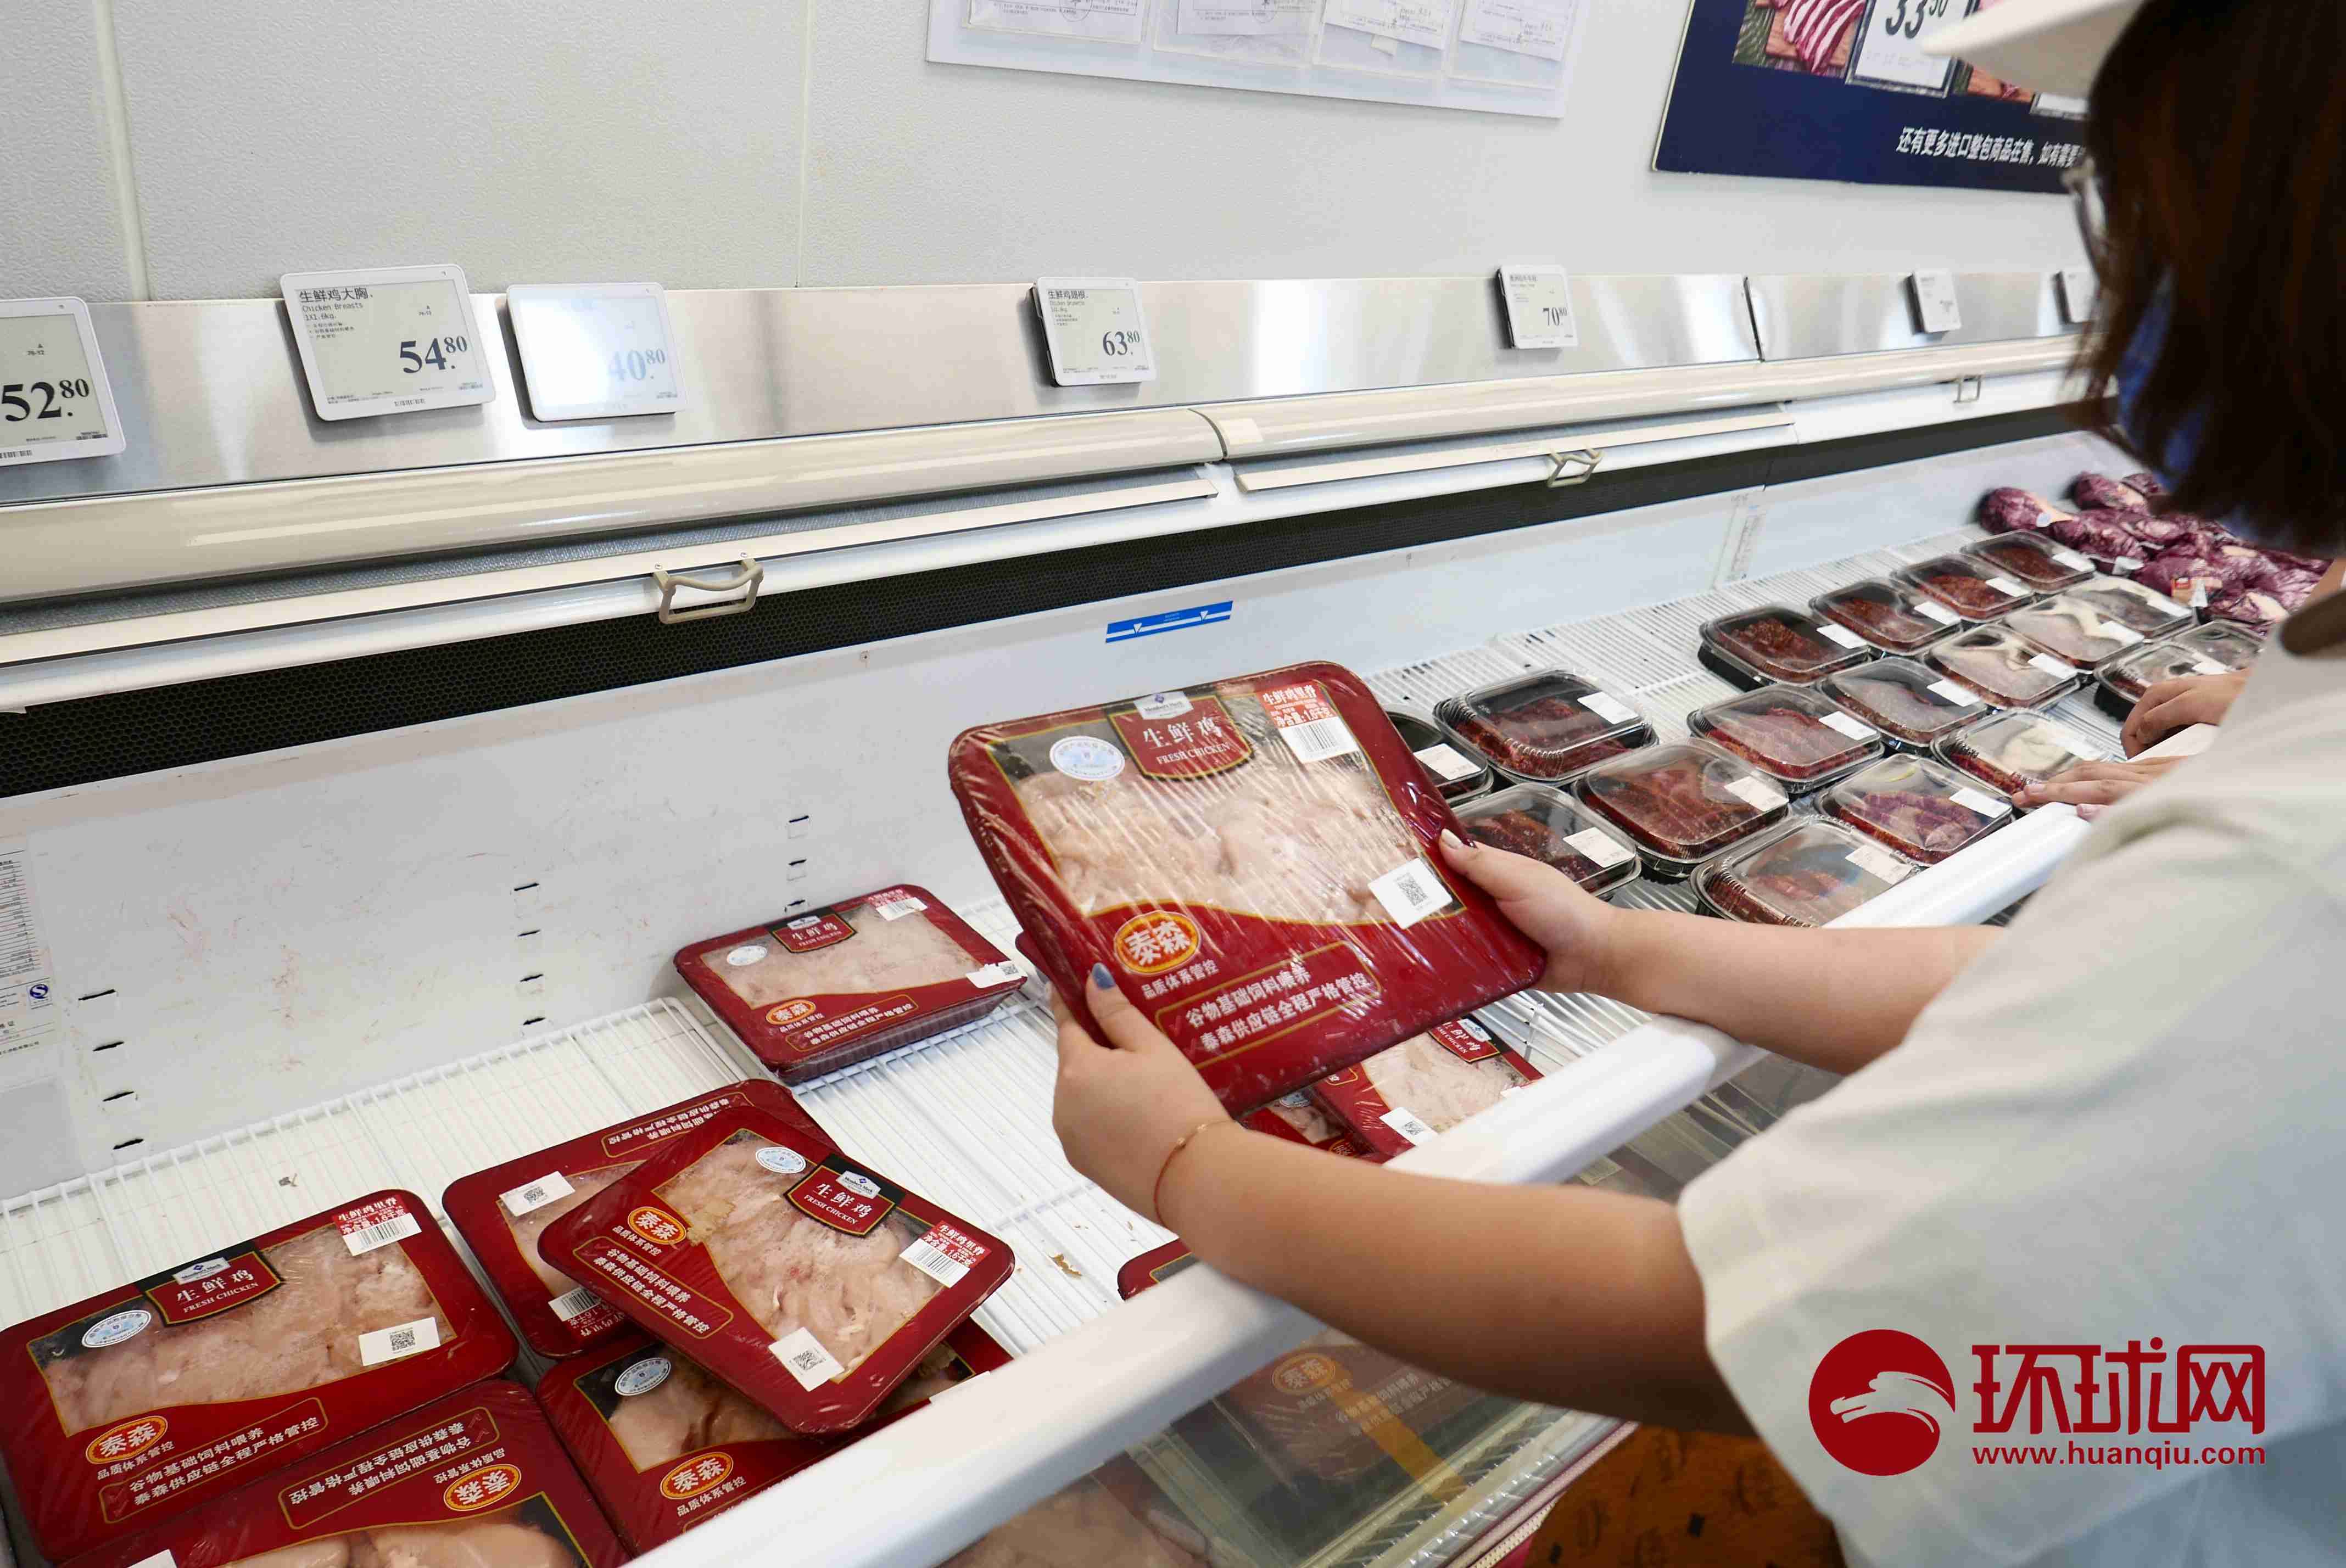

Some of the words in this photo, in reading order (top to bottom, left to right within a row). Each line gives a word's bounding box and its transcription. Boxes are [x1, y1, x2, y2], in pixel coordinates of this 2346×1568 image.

[1142, 716, 1222, 749] 生鲜鸡
[1155, 750, 1188, 765] FRESH
[1188, 742, 1231, 760] CHICKEN
[1124, 920, 1191, 966] 泰森
[1141, 959, 1220, 1000] 品质体系管控
[1200, 972, 1372, 1051] 泰森供应链全程严格管控
[803, 1194, 827, 1209] FRESH
[826, 1205, 858, 1225] CHICKEN
[812, 1183, 872, 1218] 生鲜鸡
[635, 1211, 679, 1240] 泰森
[176, 1269, 255, 1304] 生鲜鸡
[183, 1297, 215, 1314] FRESH
[216, 1282, 259, 1301] CHICKEN
[98, 1422, 157, 1458] 泰森
[96, 1440, 176, 1481] 品质体系管控
[129, 1427, 265, 1492] 谷物基础饲料喂养
[133, 1416, 320, 1506] 泰森供应链全程严格管控
[288, 1421, 465, 1506] 泰森供应链全程严格管控
[347, 1435, 472, 1496] 谷物基础饲料喂养
[672, 1458, 725, 1493] 泰森
[453, 1470, 511, 1506] 泰森
[676, 1475, 747, 1517] 品质体系管控
